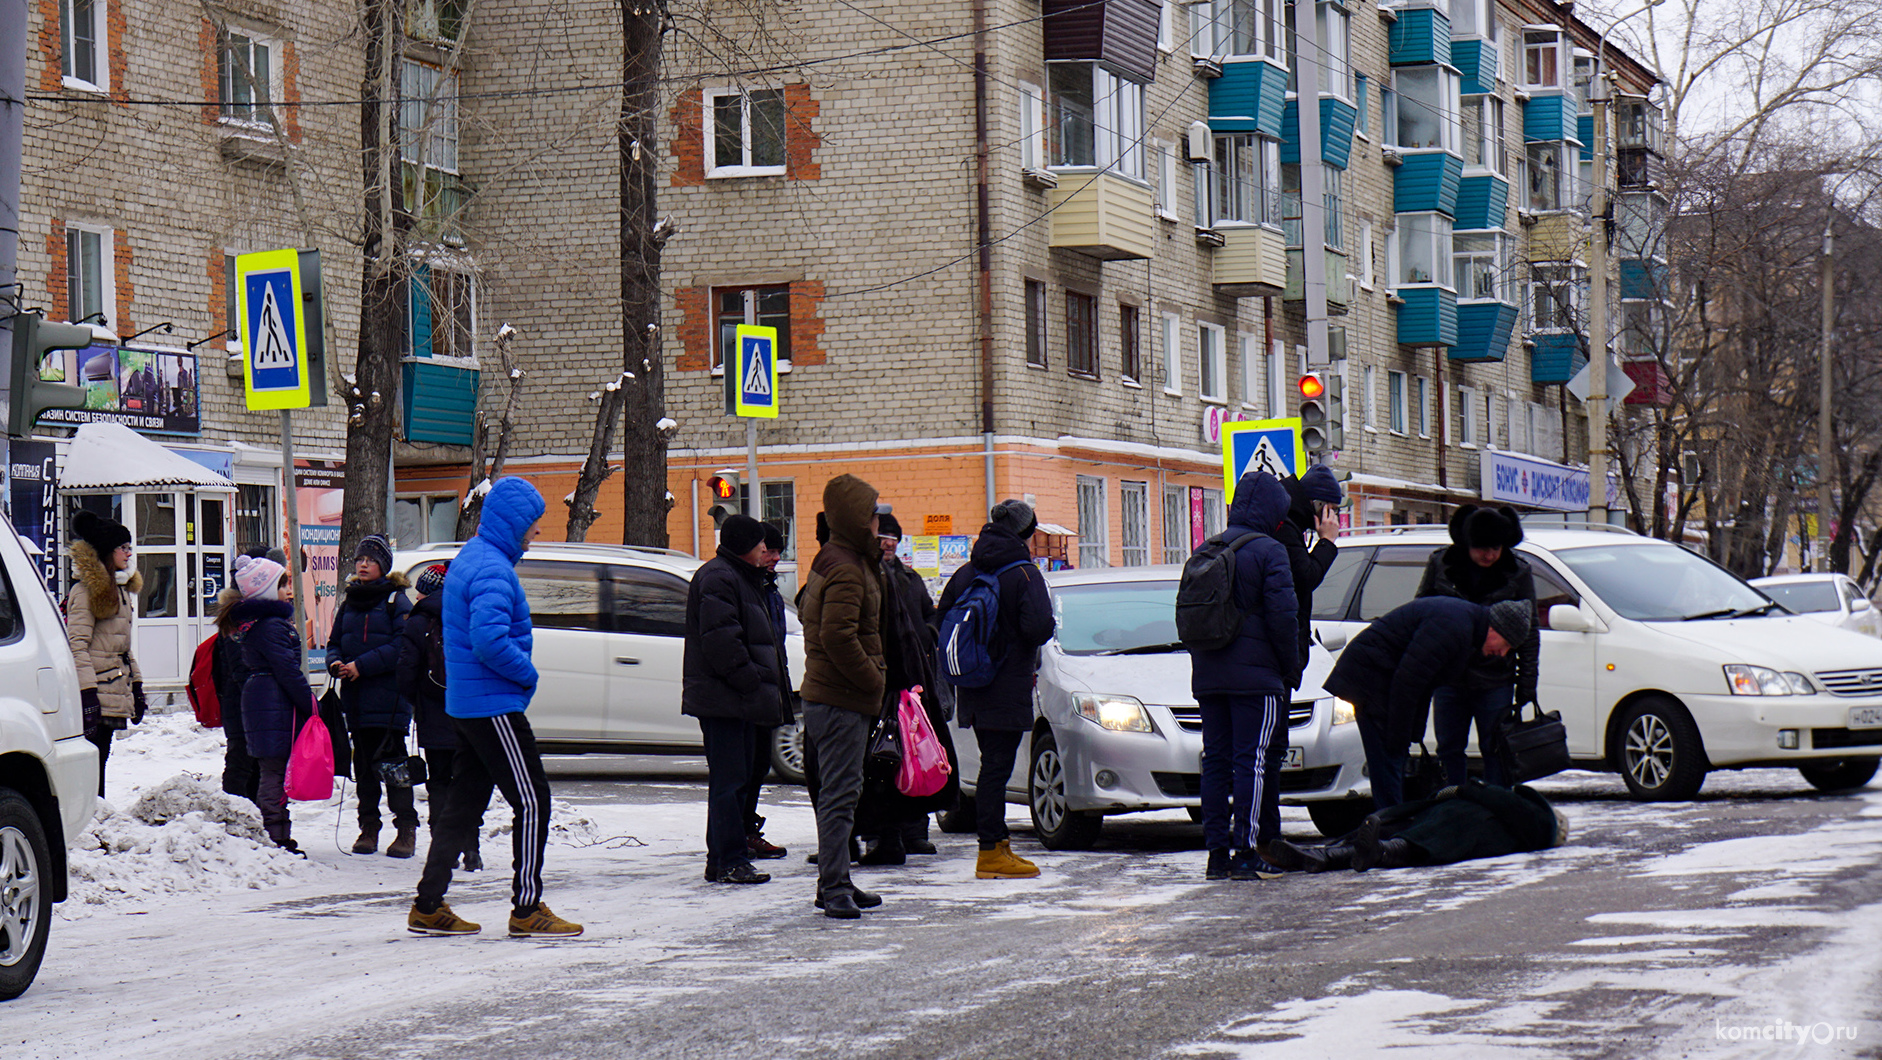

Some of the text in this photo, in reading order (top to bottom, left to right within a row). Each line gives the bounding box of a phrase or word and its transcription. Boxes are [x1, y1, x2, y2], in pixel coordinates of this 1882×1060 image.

[65, 410, 91, 423] СИСТЕМ
[91, 413, 138, 426] БЕЗОПАСНОСТИ
[139, 416, 144, 425] И
[145, 416, 164, 428] СВЯЗИ
[1496, 463, 1518, 494] БОНУС
[1531, 470, 1560, 501] ДИСКОНТ
[42, 457, 56, 599] СИНЕР
[927, 514, 950, 523] ДОЛЯ
